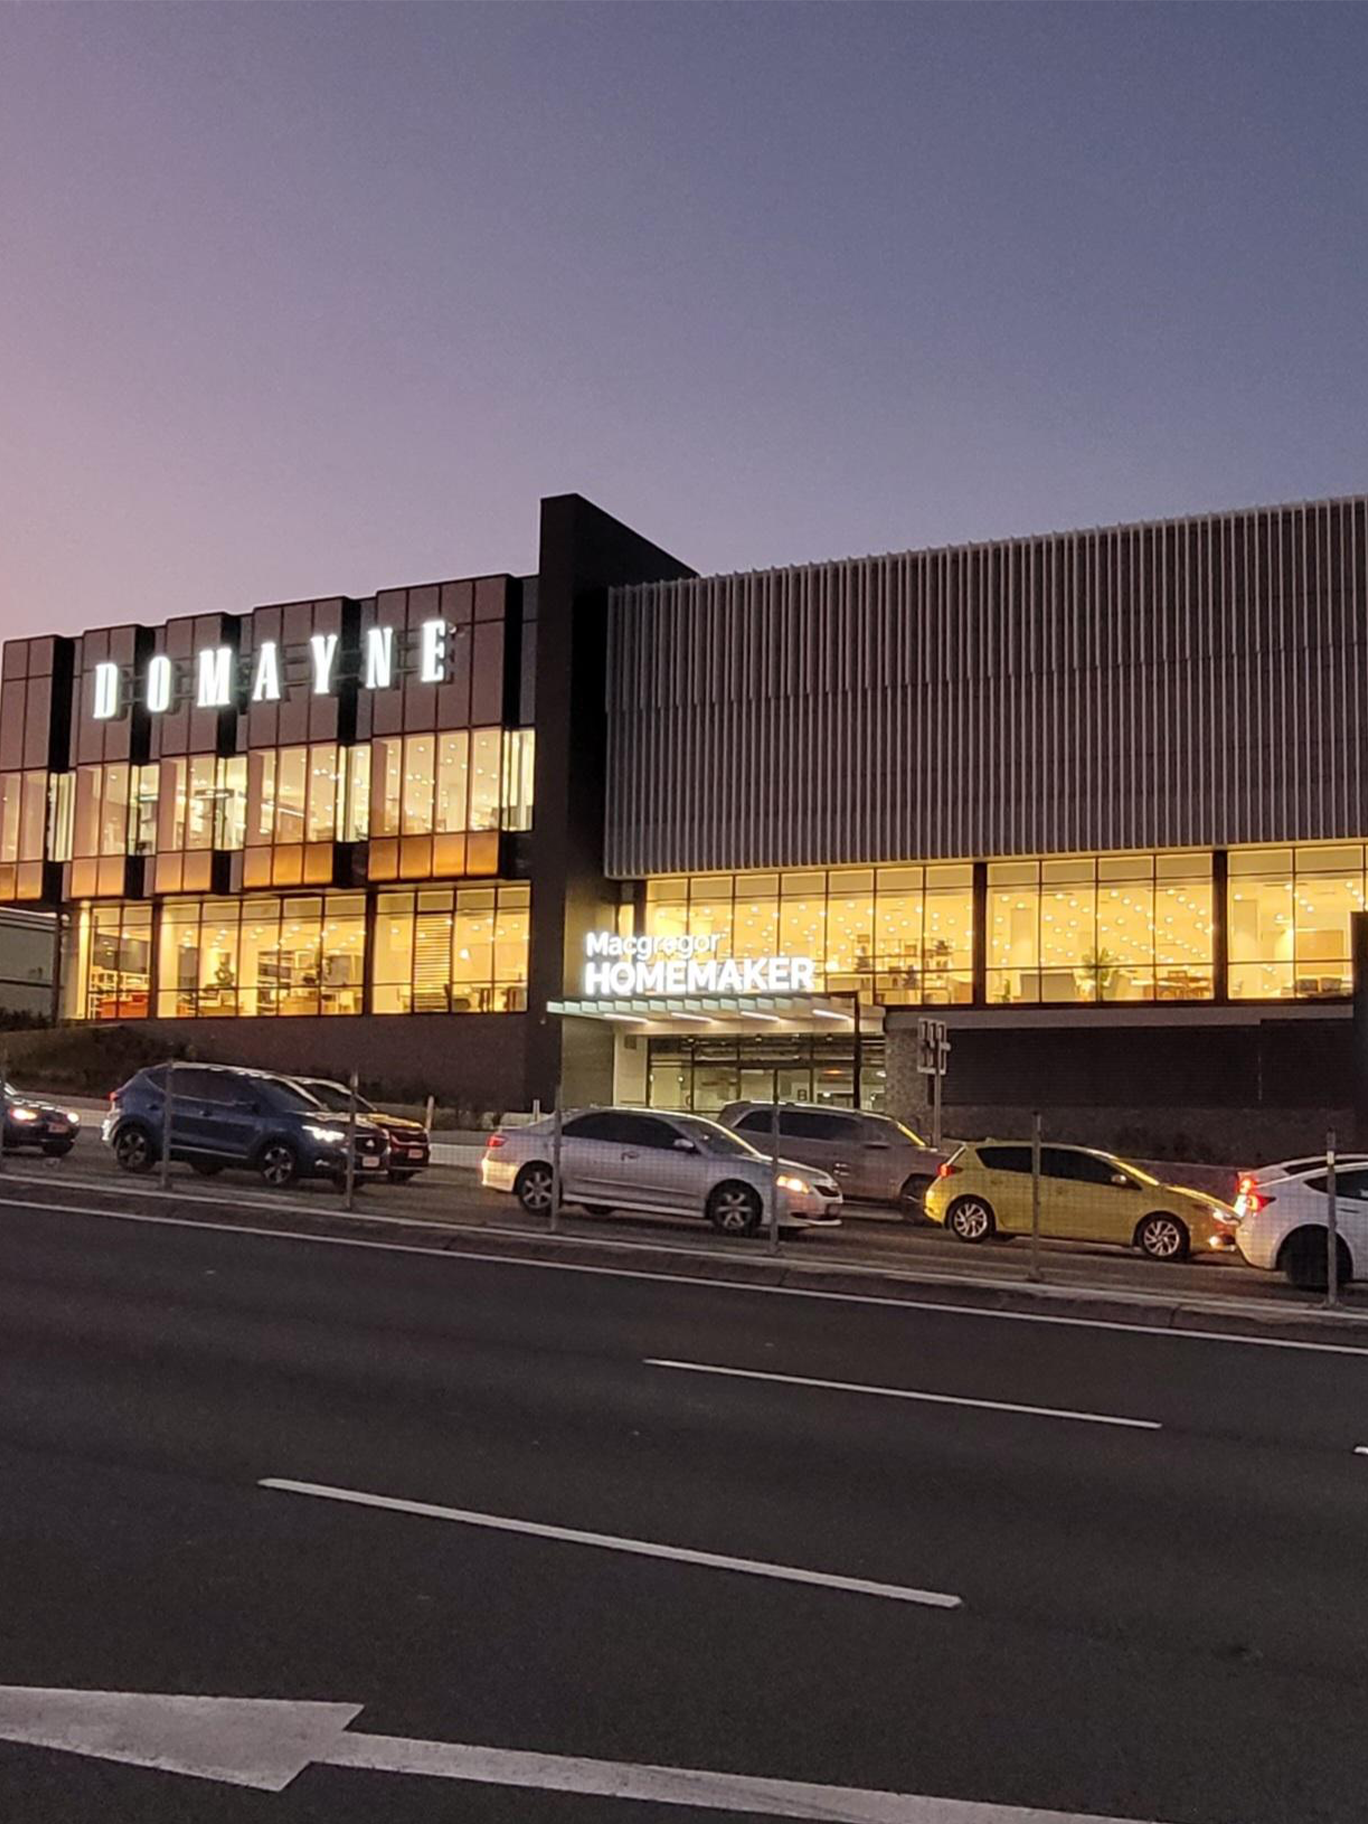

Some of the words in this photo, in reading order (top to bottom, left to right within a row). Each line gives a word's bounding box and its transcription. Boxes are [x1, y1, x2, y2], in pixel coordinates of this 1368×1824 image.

[93, 620, 446, 719] DOMAYNE
[586, 932, 720, 960] Macgregor
[584, 957, 815, 995] HOMEMAKER
